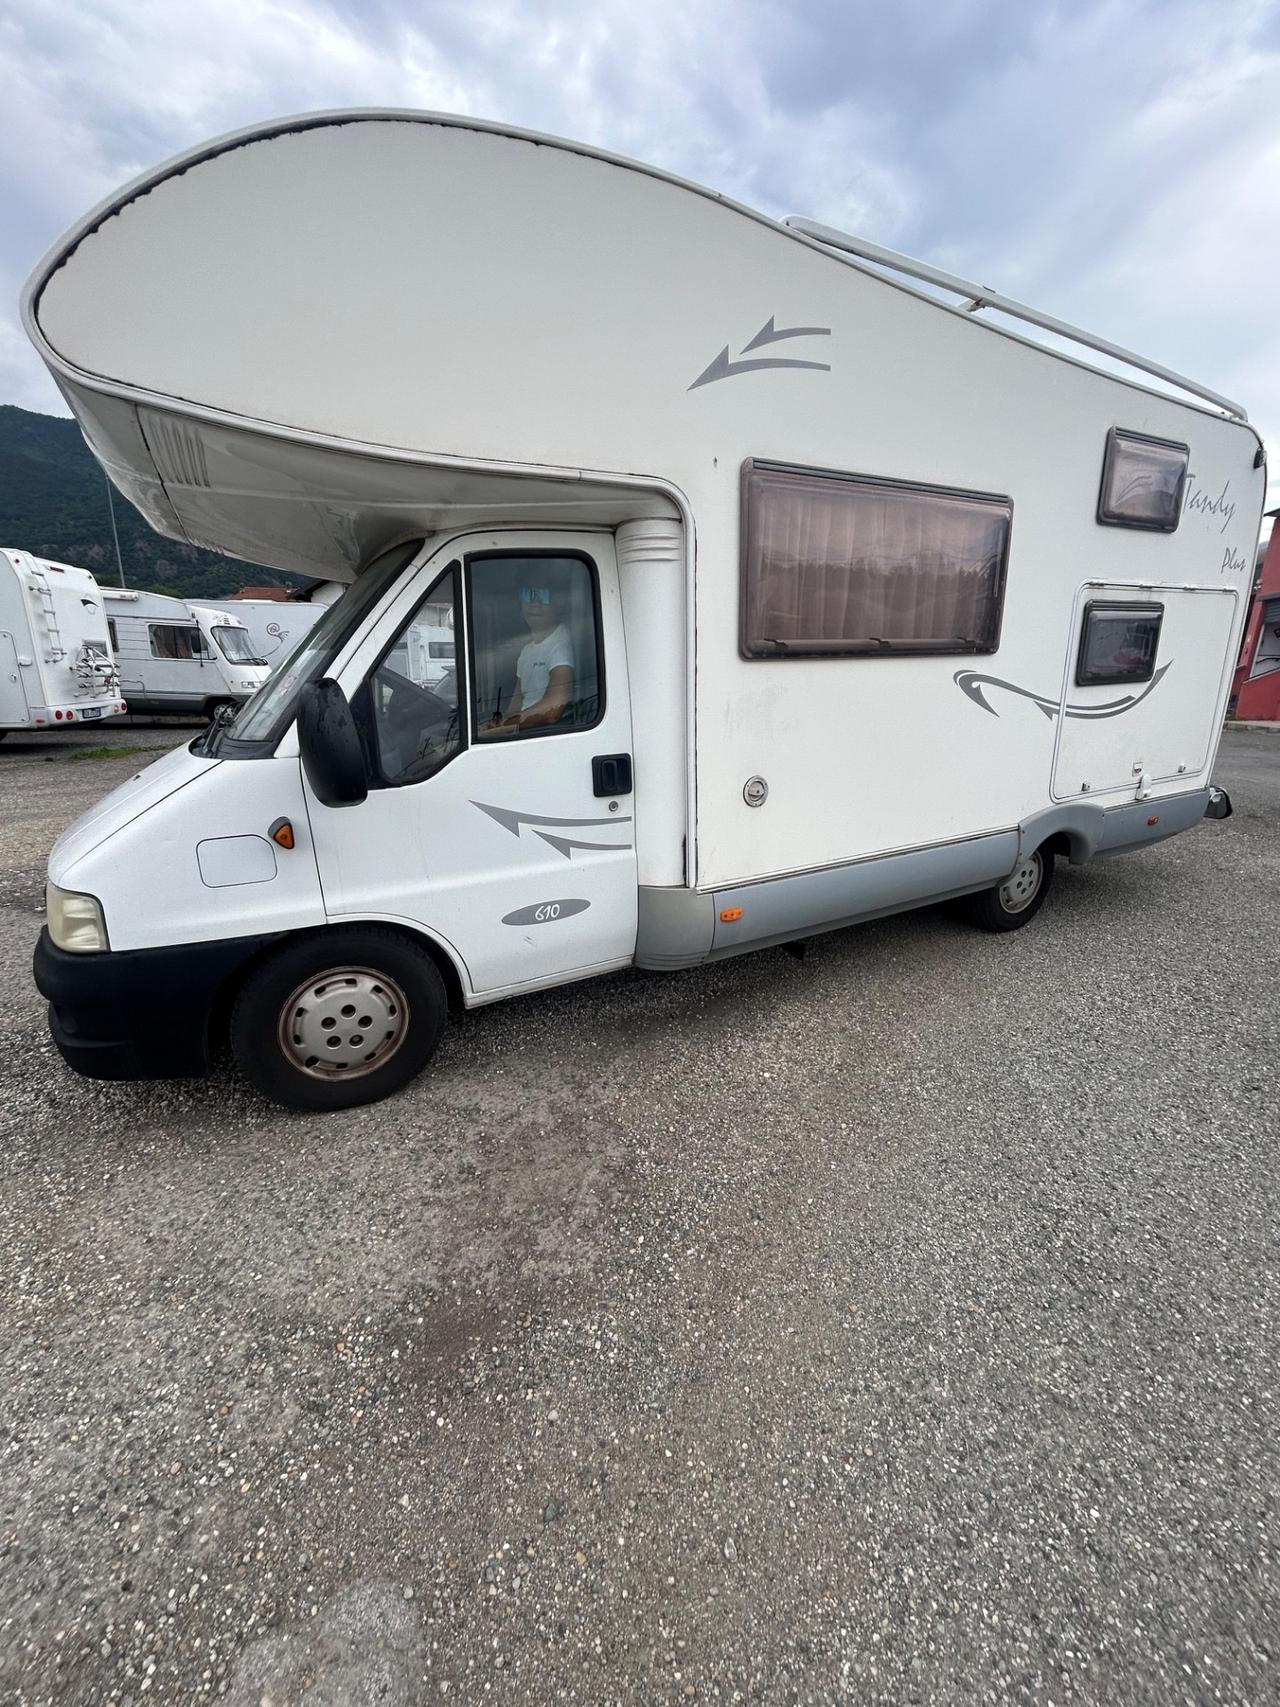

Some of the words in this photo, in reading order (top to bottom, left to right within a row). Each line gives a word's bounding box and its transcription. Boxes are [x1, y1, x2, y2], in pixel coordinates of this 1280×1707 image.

[1183, 473, 1236, 534] Tandy
[1221, 547, 1246, 574] Plus
[535, 904, 560, 920] 610
